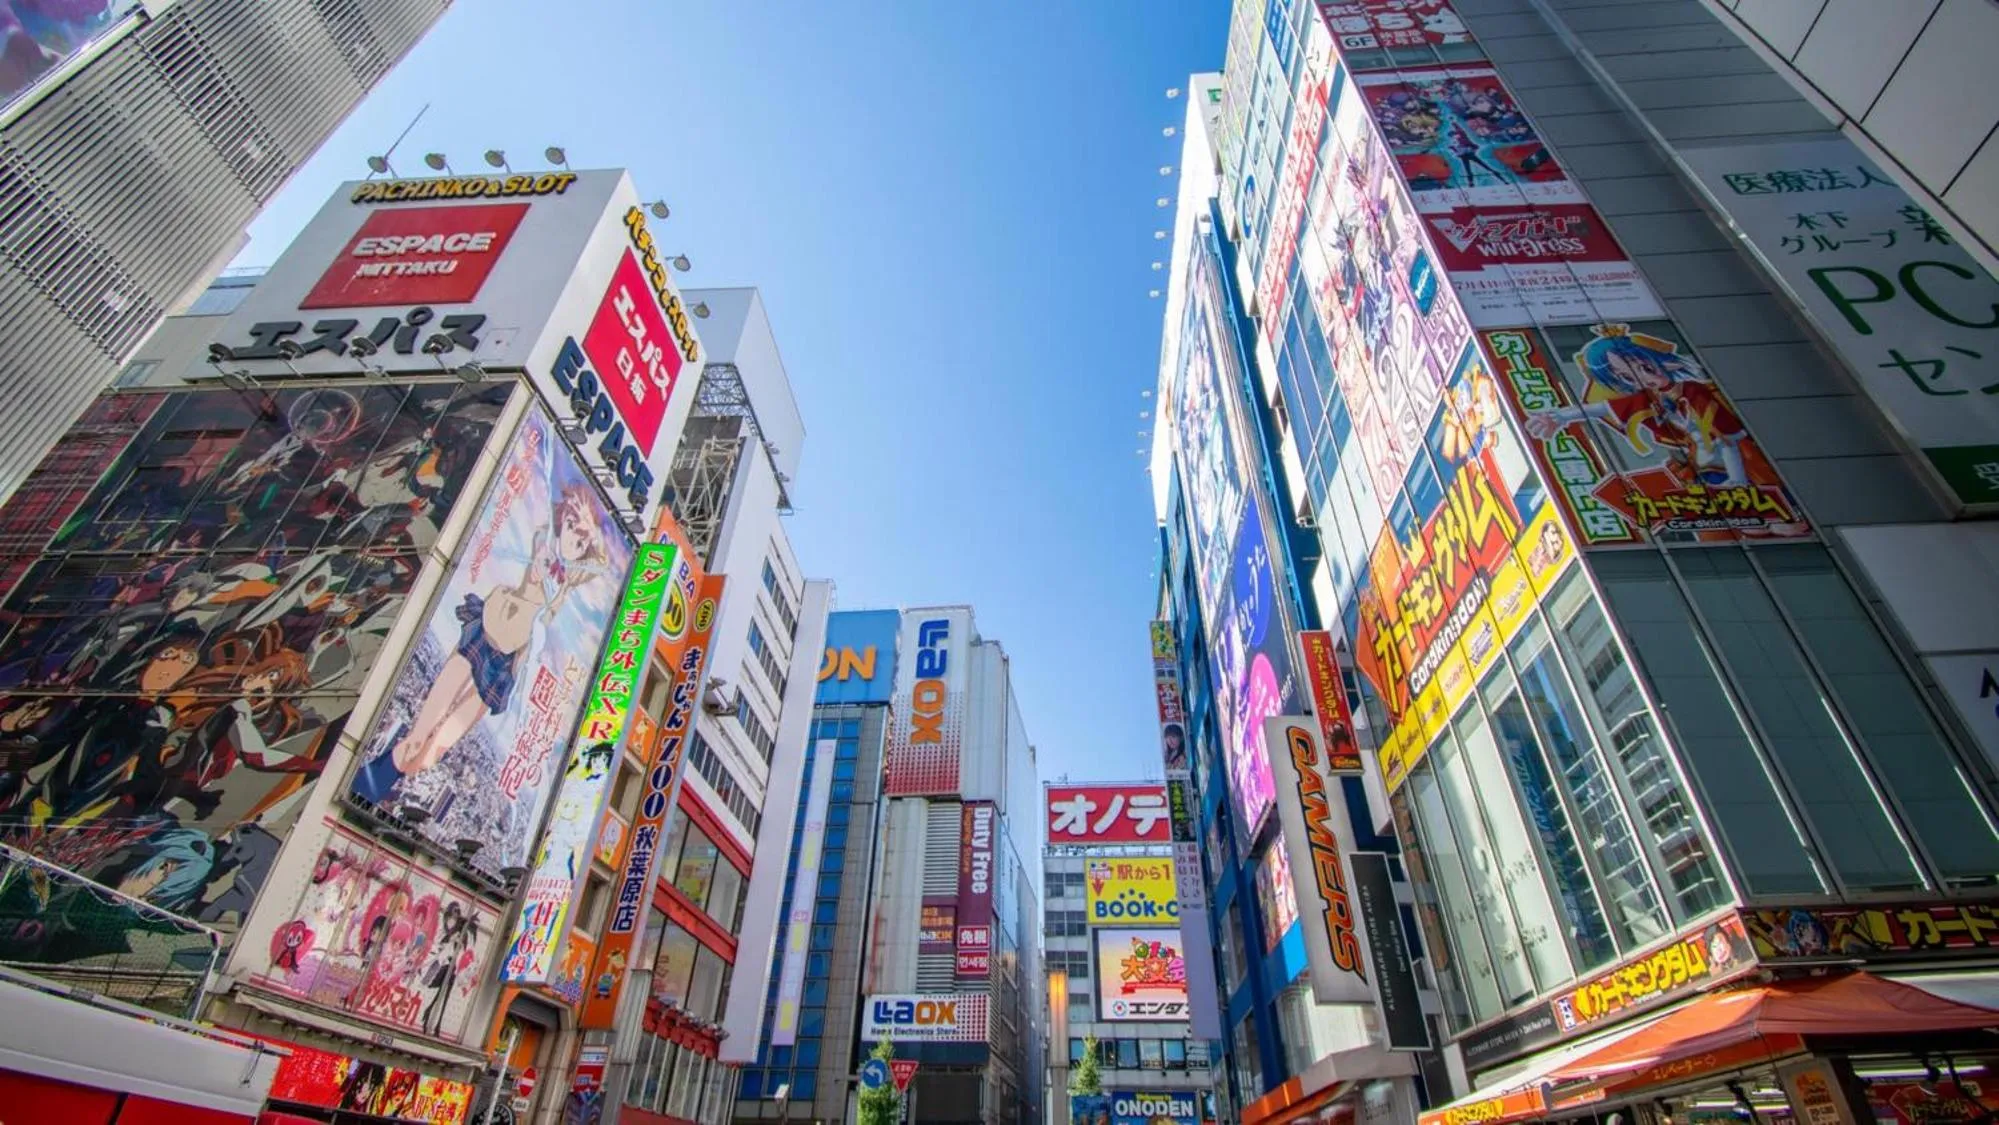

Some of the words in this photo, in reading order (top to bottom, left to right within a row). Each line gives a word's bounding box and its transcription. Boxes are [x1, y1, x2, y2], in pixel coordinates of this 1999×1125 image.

[351, 173, 577, 204] PACHINKO&SLOT
[1722, 165, 1901, 196] 医療法人
[351, 232, 496, 258] ESPACE
[1787, 211, 1849, 231] 木下
[1807, 260, 1999, 336] PC
[614, 284, 672, 401] エスパス
[550, 335, 655, 513] ESPACE
[1373, 462, 1519, 716] カードキングダム
[971, 806, 993, 849] Duty
[1286, 725, 1369, 987] GAMERS
[610, 826, 659, 933] 秋葉原店
[970, 851, 992, 895] Free
[1588, 942, 1709, 1017] カードキングダム
[1115, 1100, 1194, 1117] ONODEN
